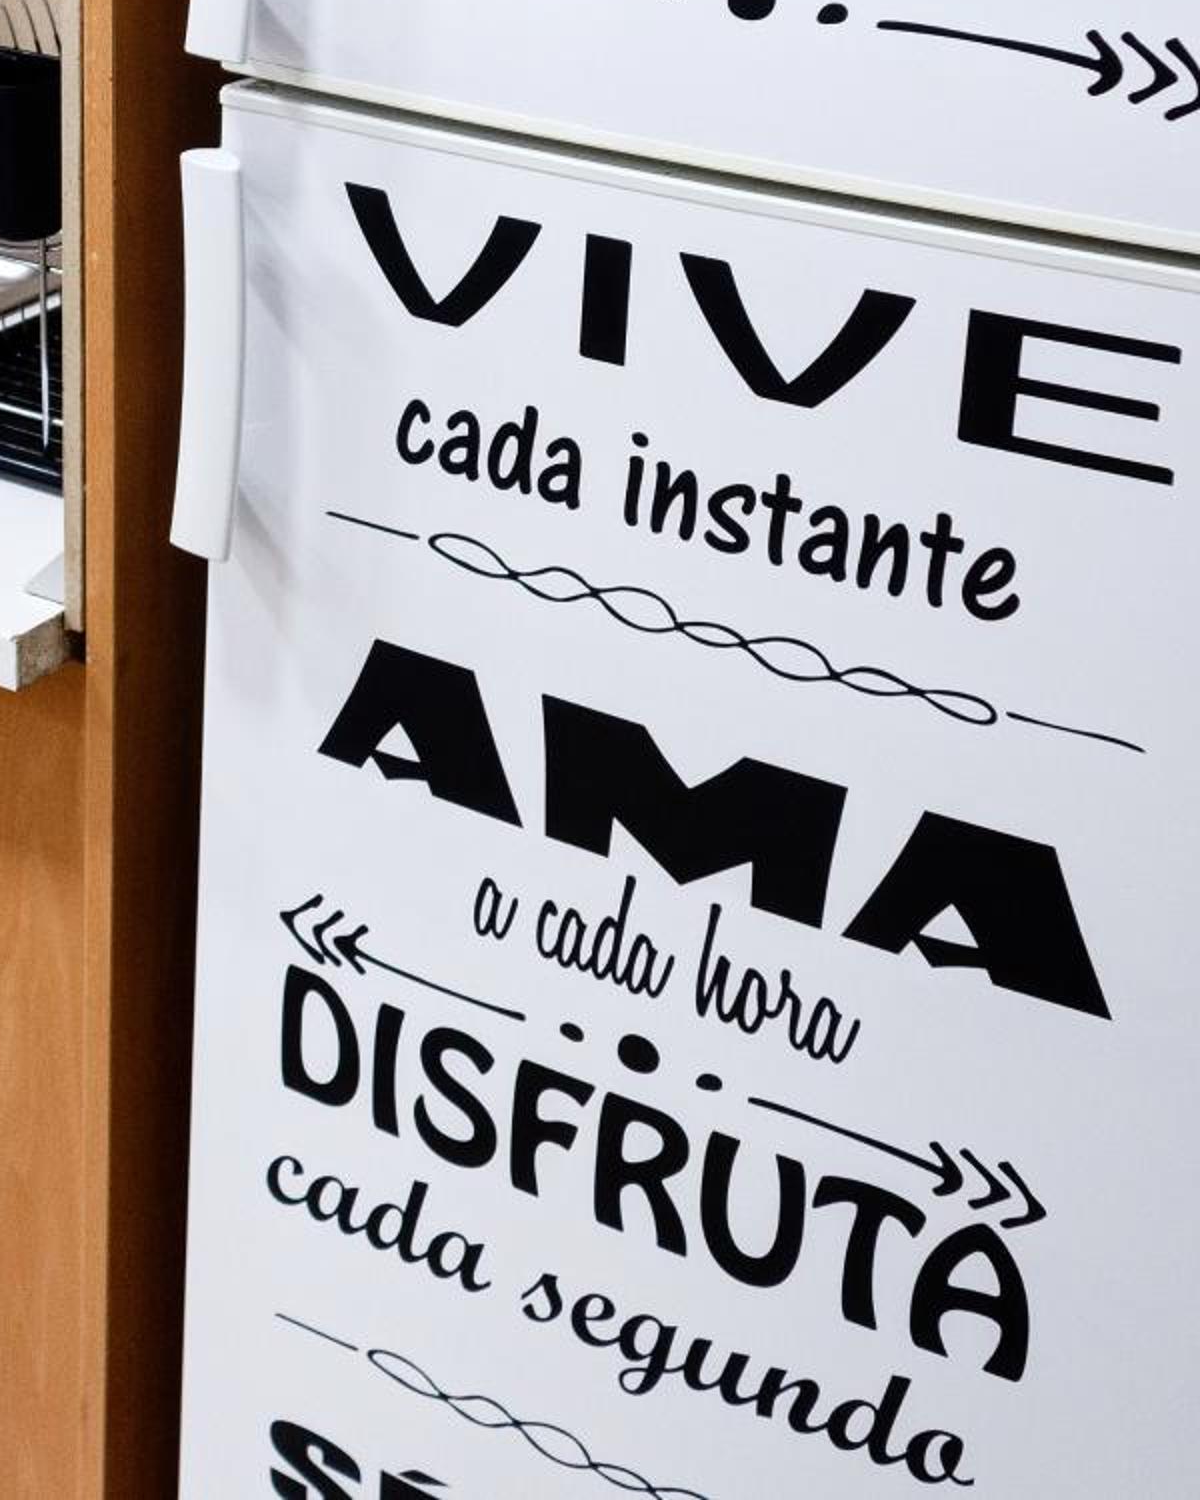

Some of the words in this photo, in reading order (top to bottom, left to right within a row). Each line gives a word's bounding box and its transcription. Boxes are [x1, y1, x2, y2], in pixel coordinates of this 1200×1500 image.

[344, 181, 1182, 486] VIVE
[396, 399, 582, 511] cada
[623, 432, 1021, 621] instante
[317, 638, 1113, 1021] AMA
[473, 877, 519, 940] a
[536, 875, 675, 999] cada
[695, 903, 861, 1064] hora
[266, 1155, 491, 1293] cada
[521, 1273, 975, 1487] segundo
[281, 964, 1030, 1383] DISFRUTA
